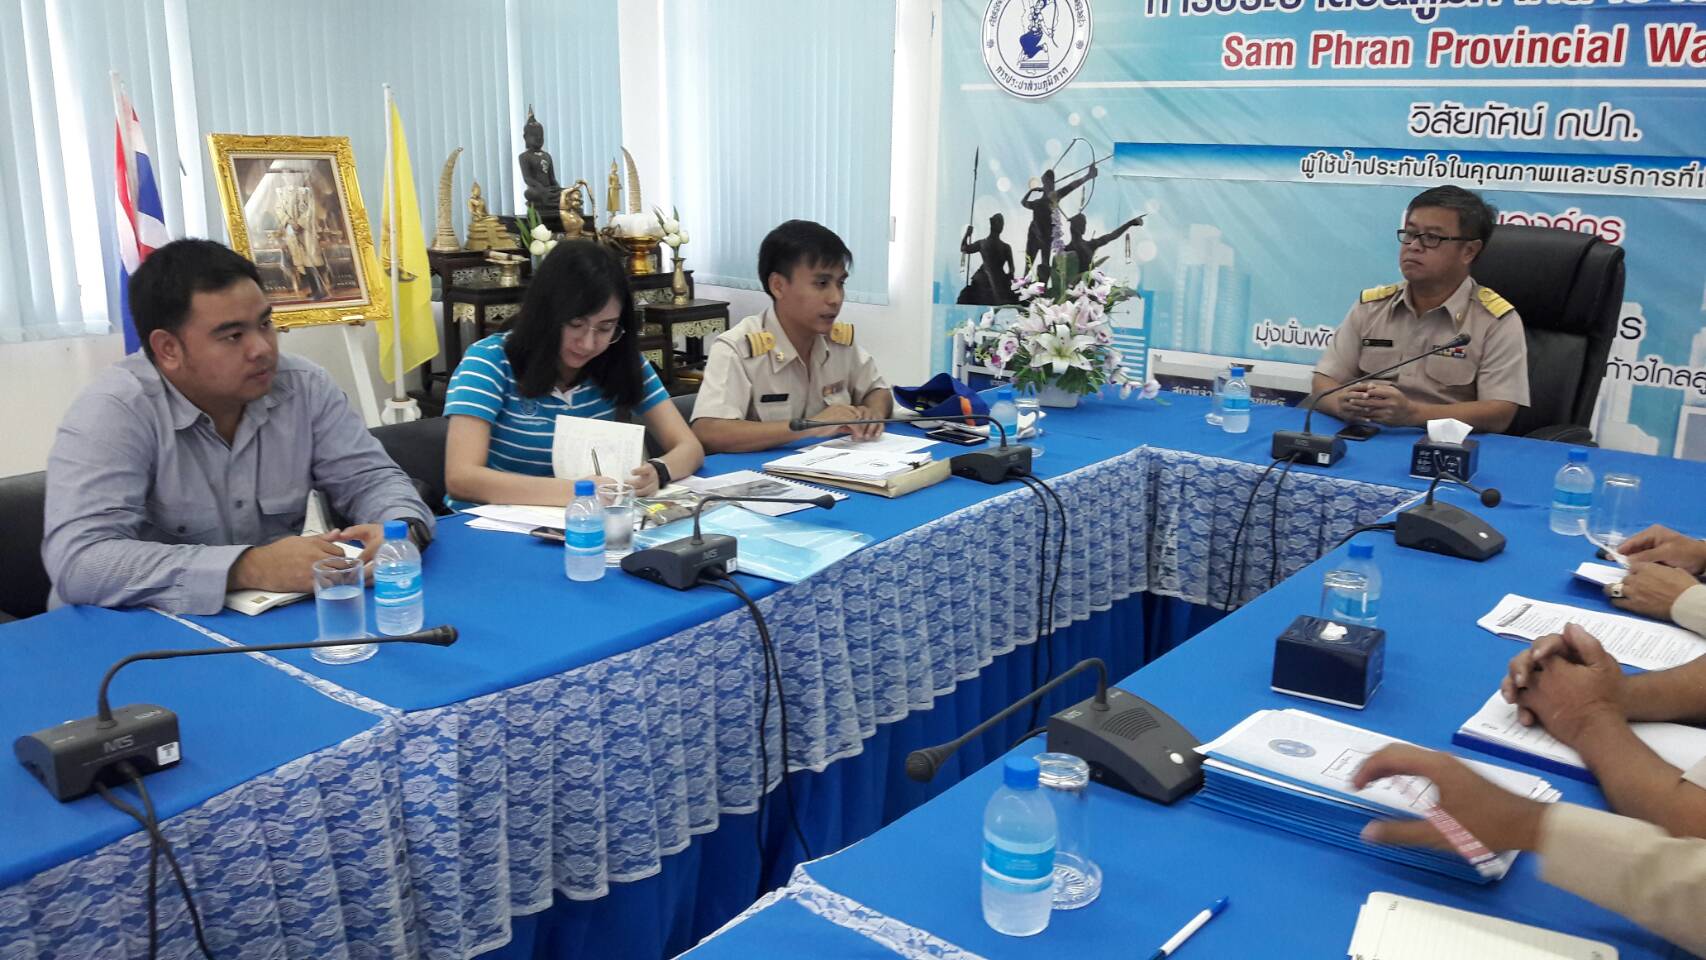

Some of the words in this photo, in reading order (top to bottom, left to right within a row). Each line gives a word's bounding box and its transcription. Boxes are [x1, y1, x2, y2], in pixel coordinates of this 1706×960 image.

[1224, 35, 1293, 67] Sam
[1312, 33, 1410, 66] Phran
[1429, 28, 1625, 65] Provincial
[1410, 103, 1545, 136] วิสัยทัศน์
